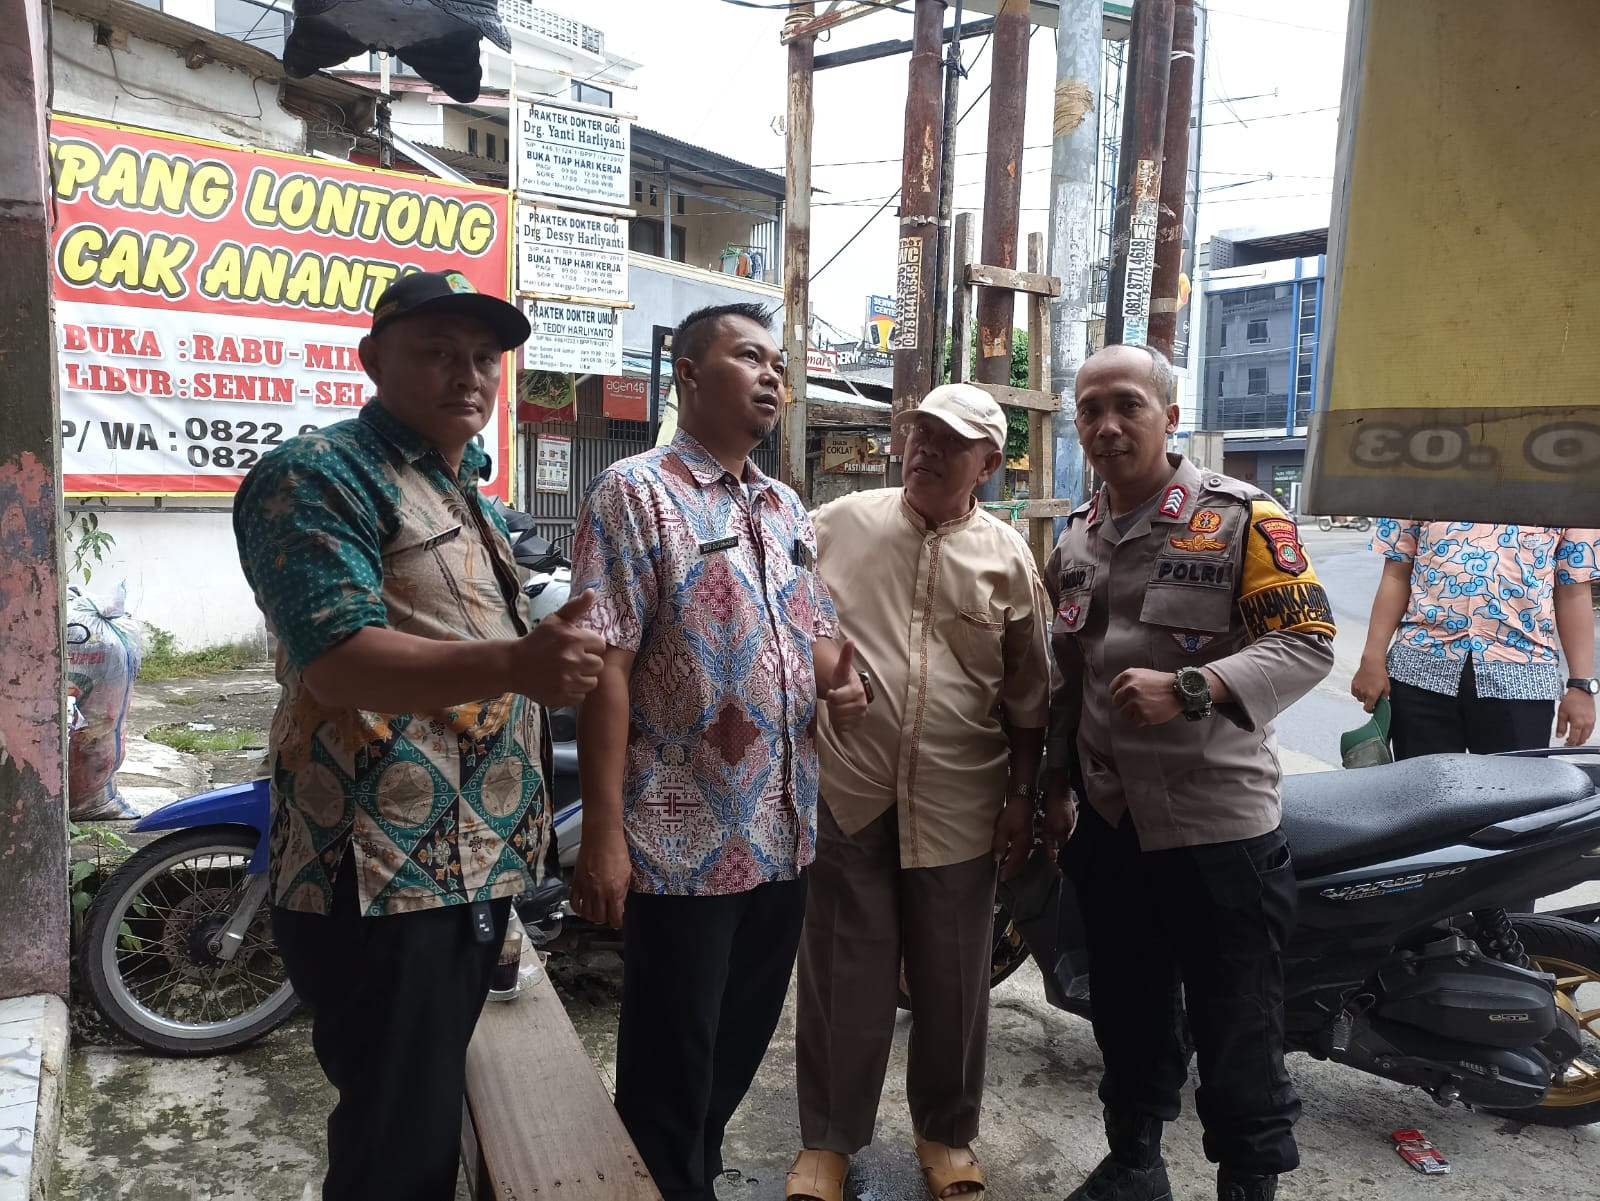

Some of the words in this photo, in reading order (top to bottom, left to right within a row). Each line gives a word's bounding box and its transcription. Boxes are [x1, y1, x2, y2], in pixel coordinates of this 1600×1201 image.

[529, 109, 567, 125] PRAKTEK
[570, 116, 602, 131] DOKTER
[604, 123, 620, 134] GIGI
[524, 121, 545, 138] Drg.
[548, 125, 574, 140] Yanti
[578, 130, 625, 150] Harliyani
[527, 151, 550, 162] BUKA
[553, 155, 572, 165] TIAP
[574, 159, 594, 170] HARI
[596, 163, 622, 174] KERJA
[50, 138, 234, 217] PANG
[246, 170, 495, 255] LONTONG
[529, 212, 567, 227] PRAKTEK
[570, 217, 602, 231] DOKTER
[604, 223, 619, 233] GIGI
[546, 229, 574, 245] Dessy
[577, 231, 625, 249] Harliyanti
[528, 254, 551, 264] BUKA
[553, 257, 572, 267] TIAP
[574, 260, 594, 269] HARI
[596, 262, 621, 272] KERJA
[1129, 241, 1146, 266] 4618
[58, 225, 193, 300] CAK
[200, 243, 425, 313] ANANT
[1126, 267, 1144, 290] 8771
[529, 305, 564, 320] PRAKTEK
[566, 308, 595, 323] DOKTER
[597, 312, 618, 325] UMUM
[1124, 291, 1141, 316] 0812
[63, 324, 162, 357] BUKA
[543, 323, 566, 333] TEDDY
[568, 326, 613, 338] HARLIYANTO
[904, 320, 916, 347] 0878
[606, 380, 645, 393] agen46
[185, 417, 284, 446] 0822
[187, 444, 273, 470] 082
[826, 446, 853, 454] COKLAT
[1158, 562, 1224, 584] POLRI
[1427, 866, 1468, 880] 150
